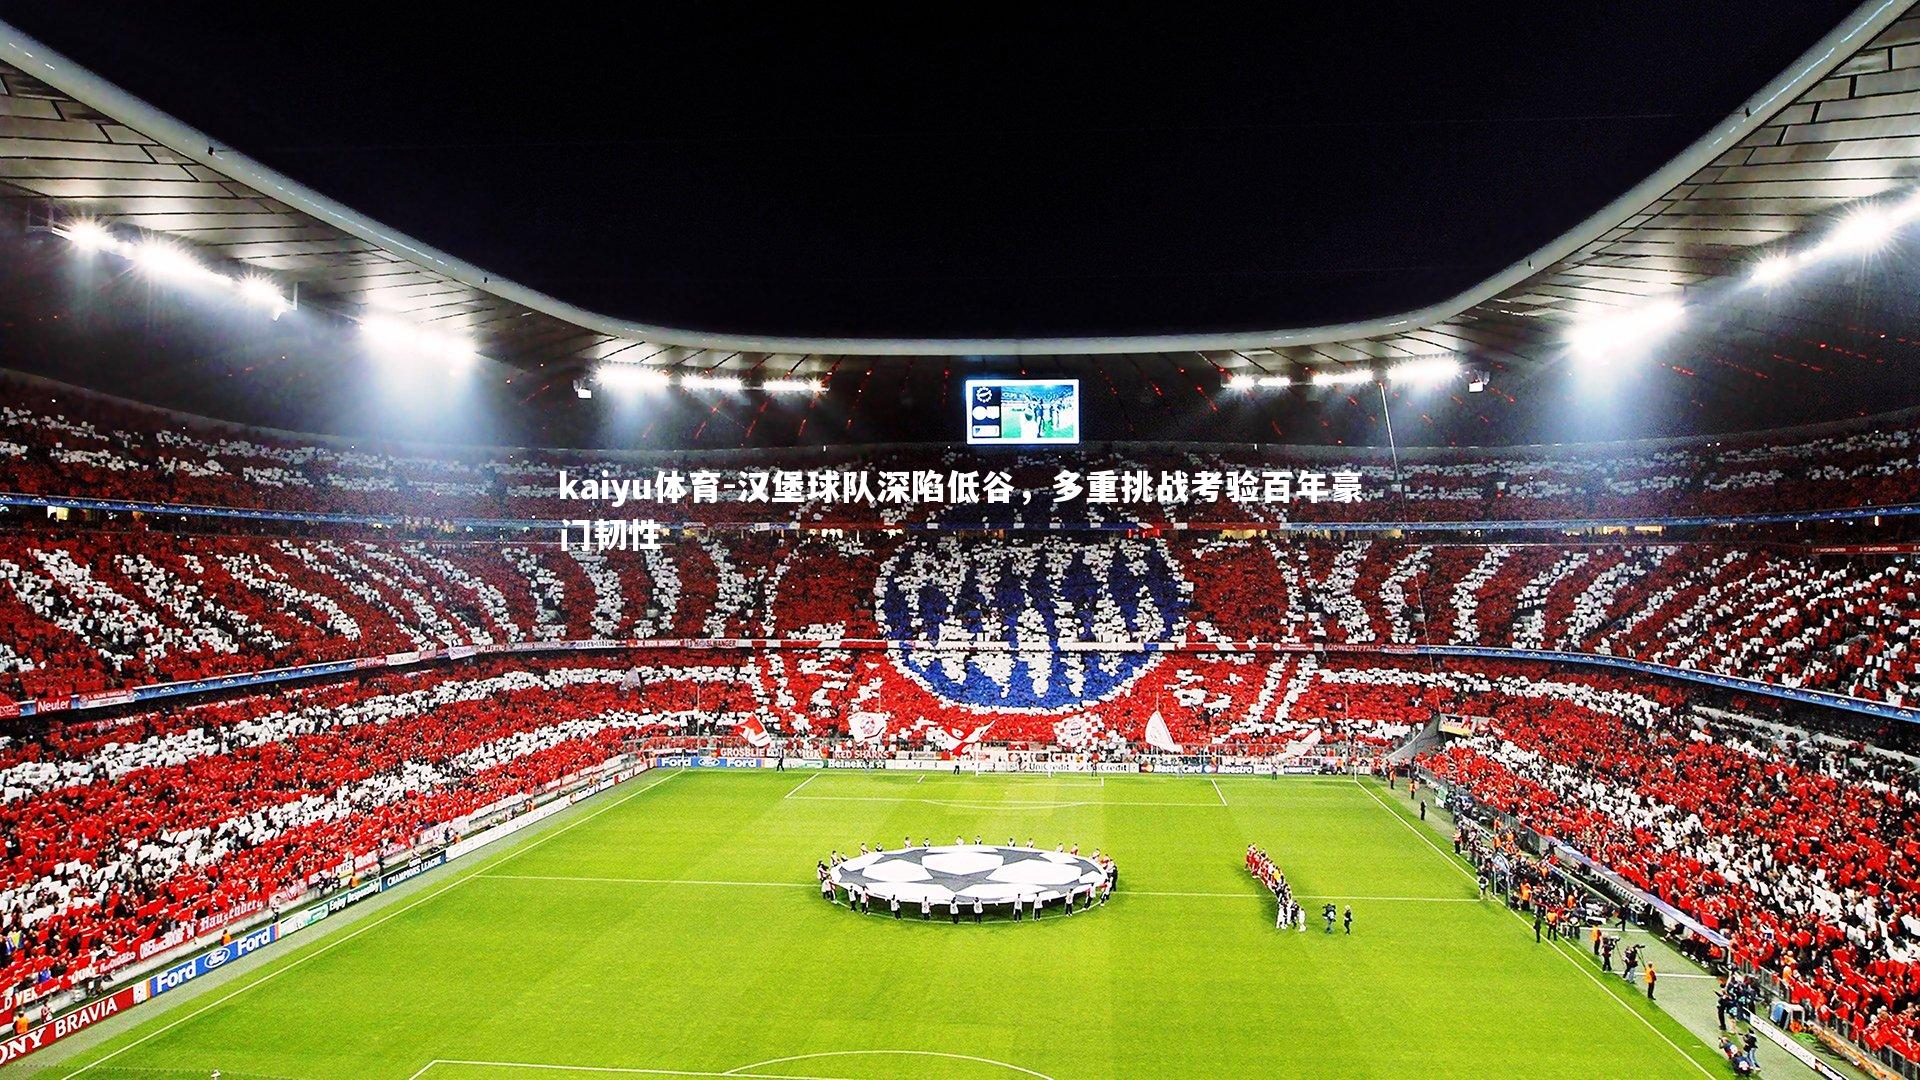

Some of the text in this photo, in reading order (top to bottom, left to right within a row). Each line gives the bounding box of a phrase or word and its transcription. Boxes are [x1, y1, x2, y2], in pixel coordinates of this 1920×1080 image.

[37, 699, 70, 713] Neuler
[854, 749, 890, 759] SHARKS
[661, 758, 692, 767] Ford
[727, 758, 757, 768] Ford
[329, 895, 348, 911] Enjoy
[238, 927, 270, 956] Ford
[156, 958, 196, 993] Ford
[54, 996, 118, 1039] BRAVIA
